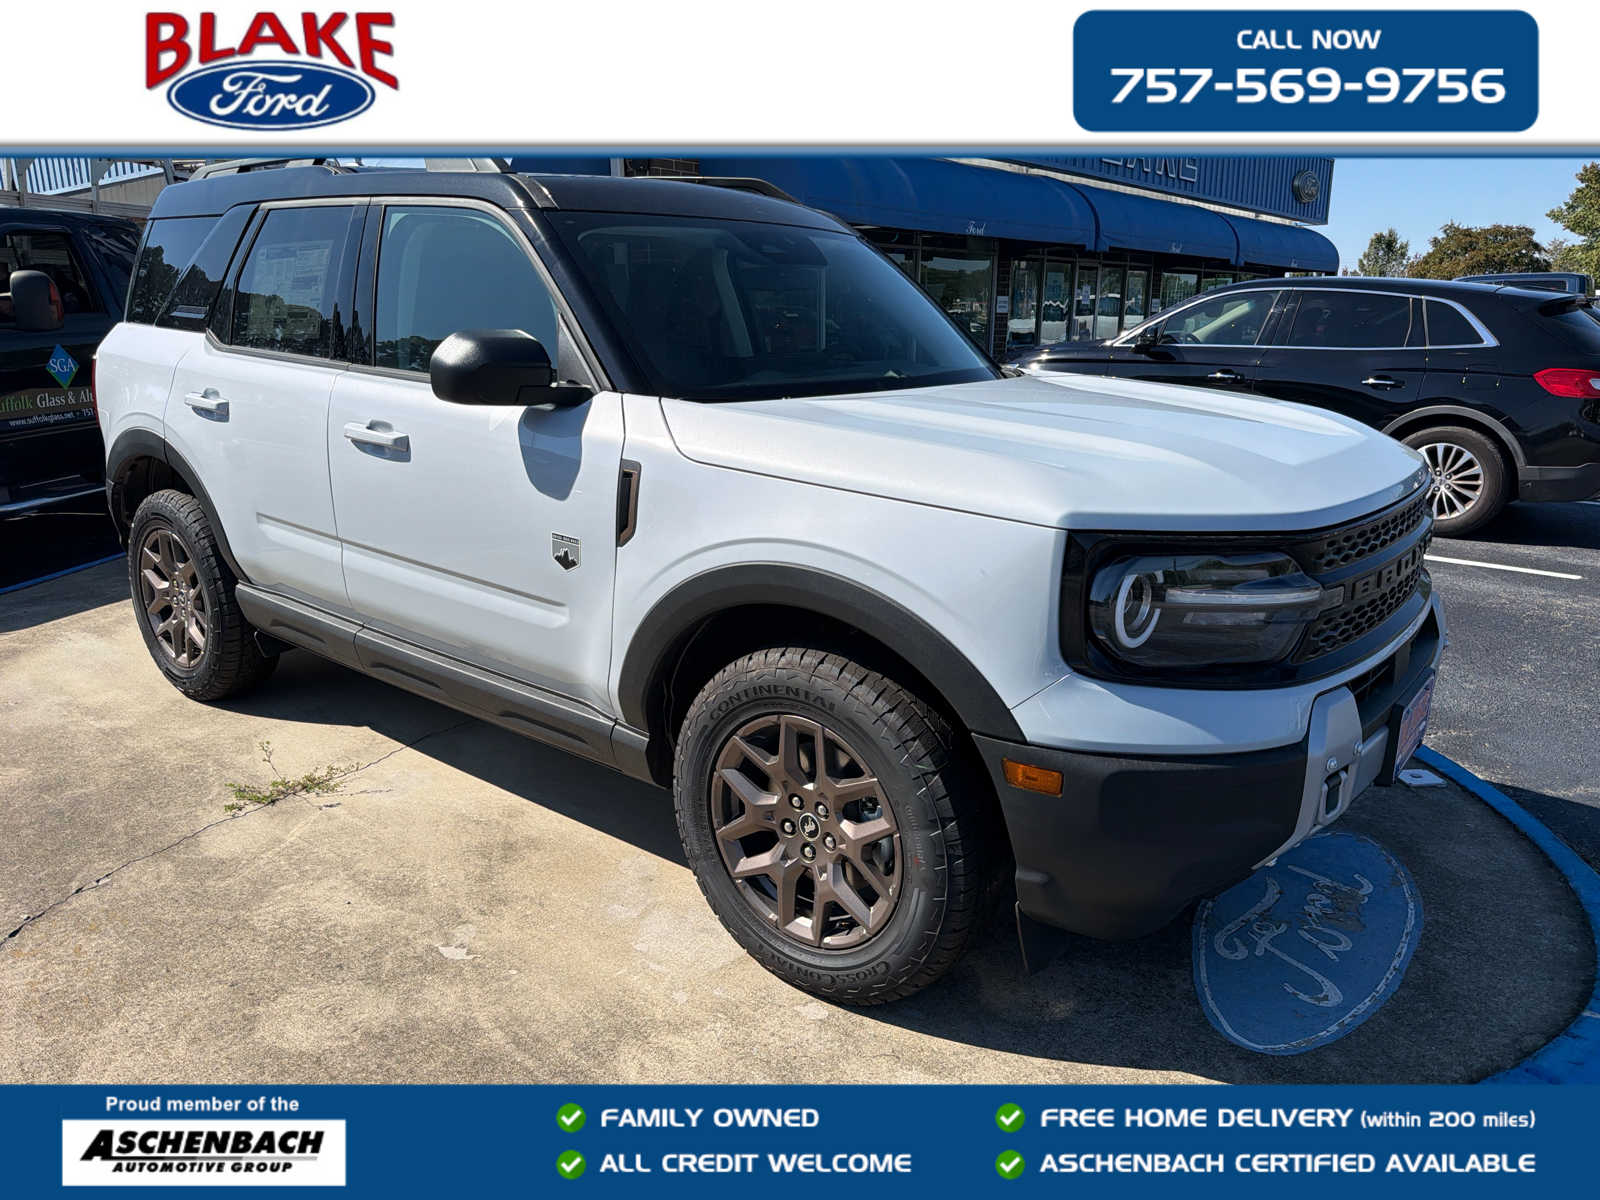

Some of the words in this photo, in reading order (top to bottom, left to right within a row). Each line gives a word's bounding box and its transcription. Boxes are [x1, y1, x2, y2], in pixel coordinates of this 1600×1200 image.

[49, 358, 76, 373] SGA
[36, 393, 66, 409] Glass
[710, 684, 836, 721] CONTINENTAL
